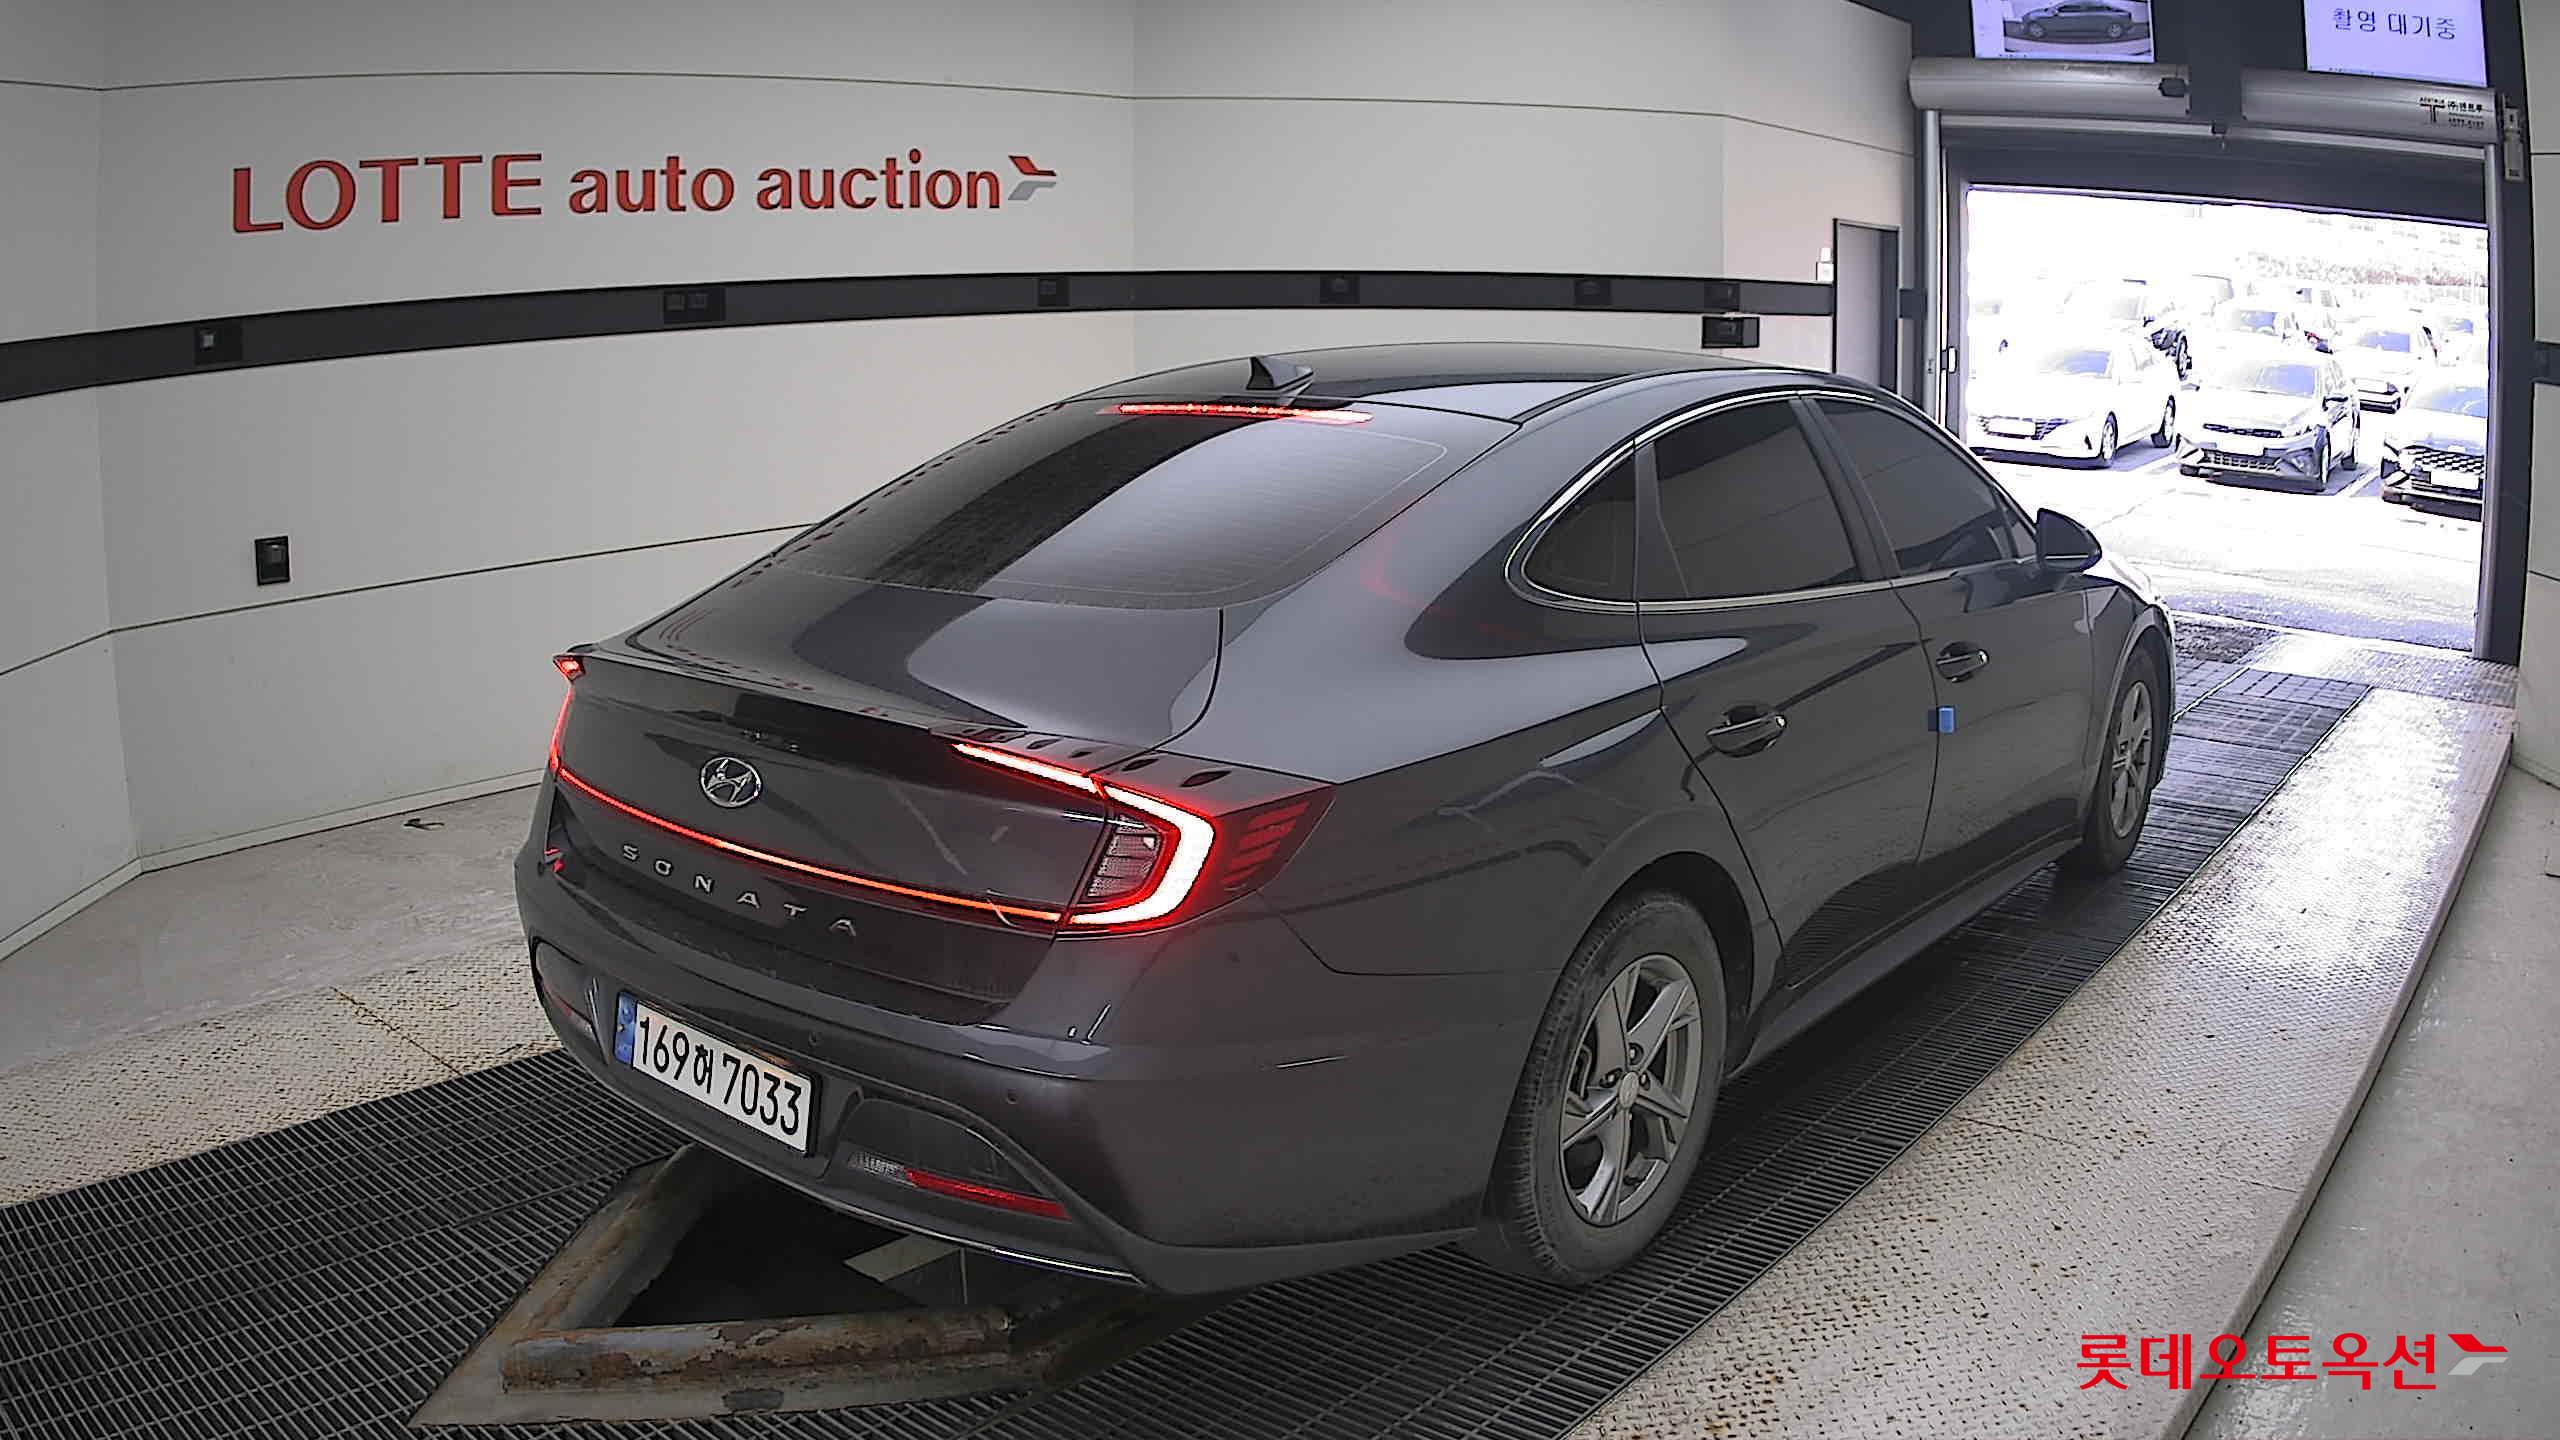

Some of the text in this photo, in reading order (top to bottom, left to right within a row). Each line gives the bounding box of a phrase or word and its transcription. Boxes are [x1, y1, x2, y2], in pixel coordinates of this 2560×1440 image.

[2333, 8, 2456, 41] 촬영 대기중
[233, 148, 1001, 234] LOTTE auto auction
[622, 844, 858, 937] SONATA
